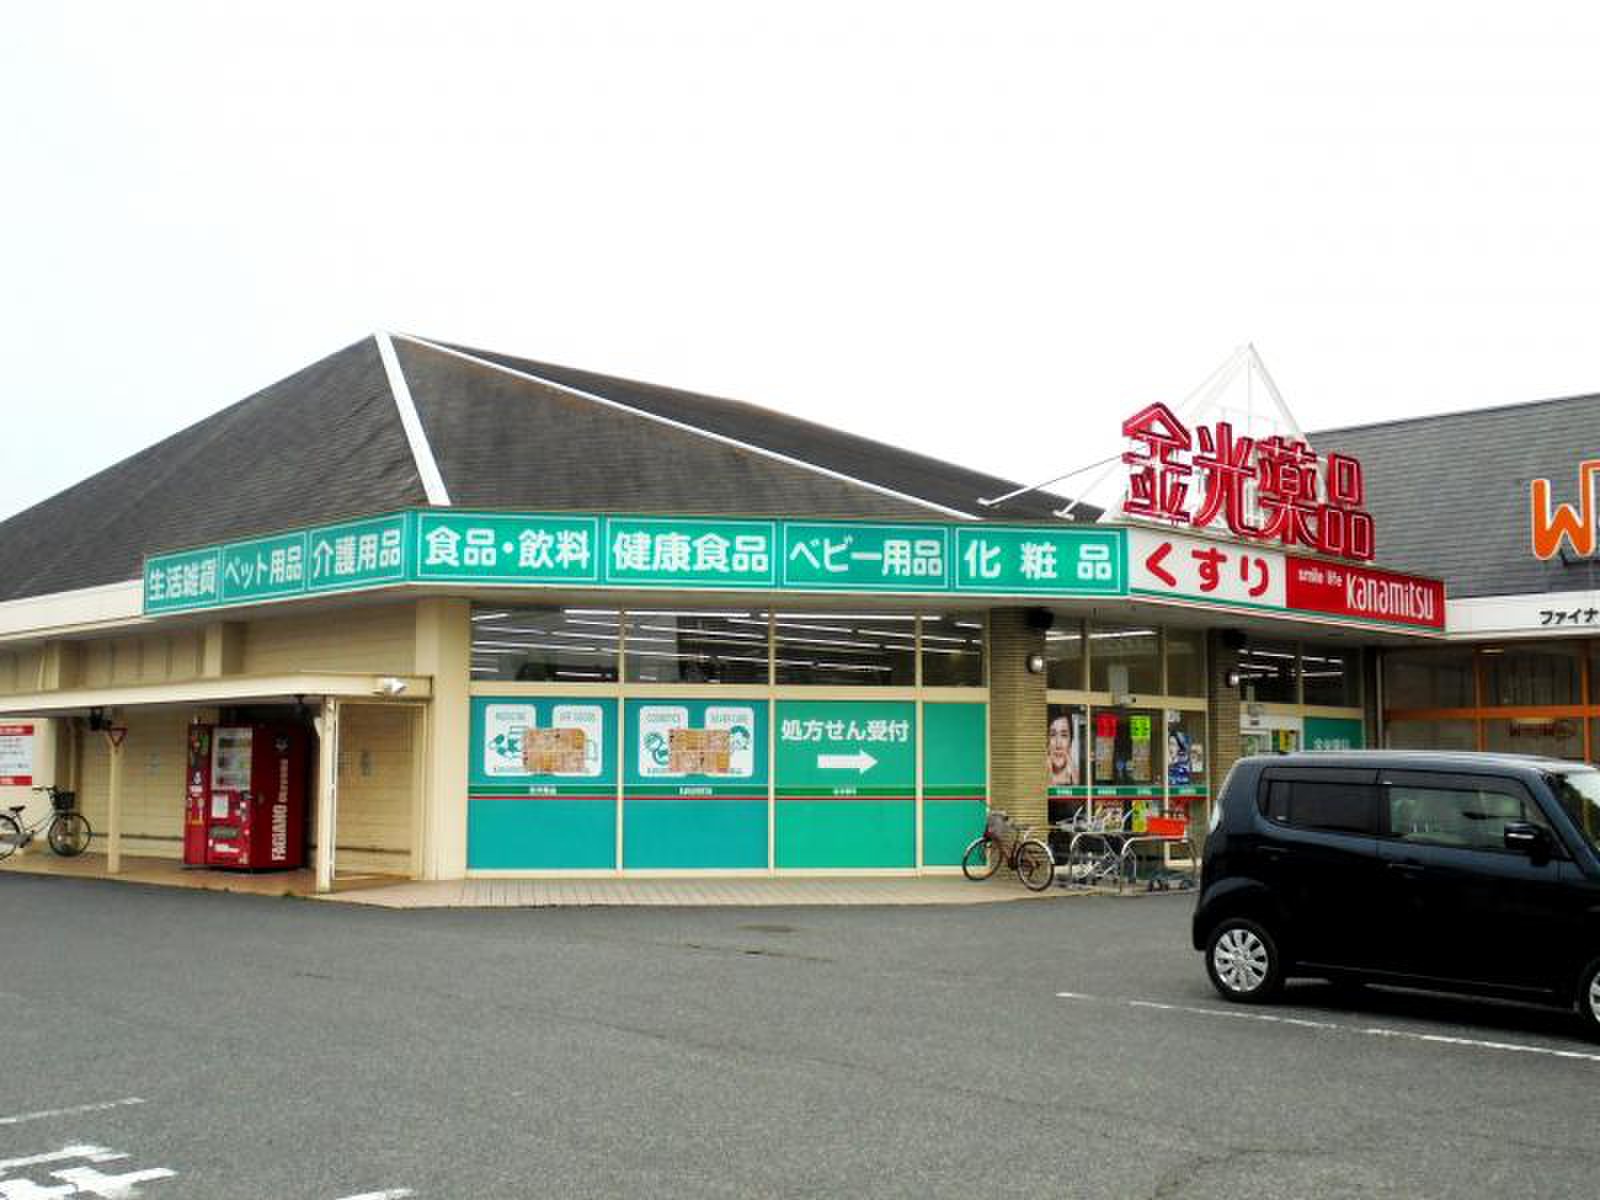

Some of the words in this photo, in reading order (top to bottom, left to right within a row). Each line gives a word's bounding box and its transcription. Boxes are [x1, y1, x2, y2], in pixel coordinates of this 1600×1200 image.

[1122, 402, 1375, 561] 金光薬品
[224, 545, 302, 590] ペット用品
[313, 529, 401, 579] 介護用品
[425, 526, 592, 568] 食品・飲料
[612, 532, 769, 572] 健康食品
[789, 536, 943, 577] ベビー用品
[964, 540, 1113, 580] 化粧品
[149, 558, 217, 601] 生活雑貨
[1145, 543, 1270, 597] くすり
[1539, 607, 1598, 625] ファイナ
[781, 719, 909, 742] 処方せん受付
